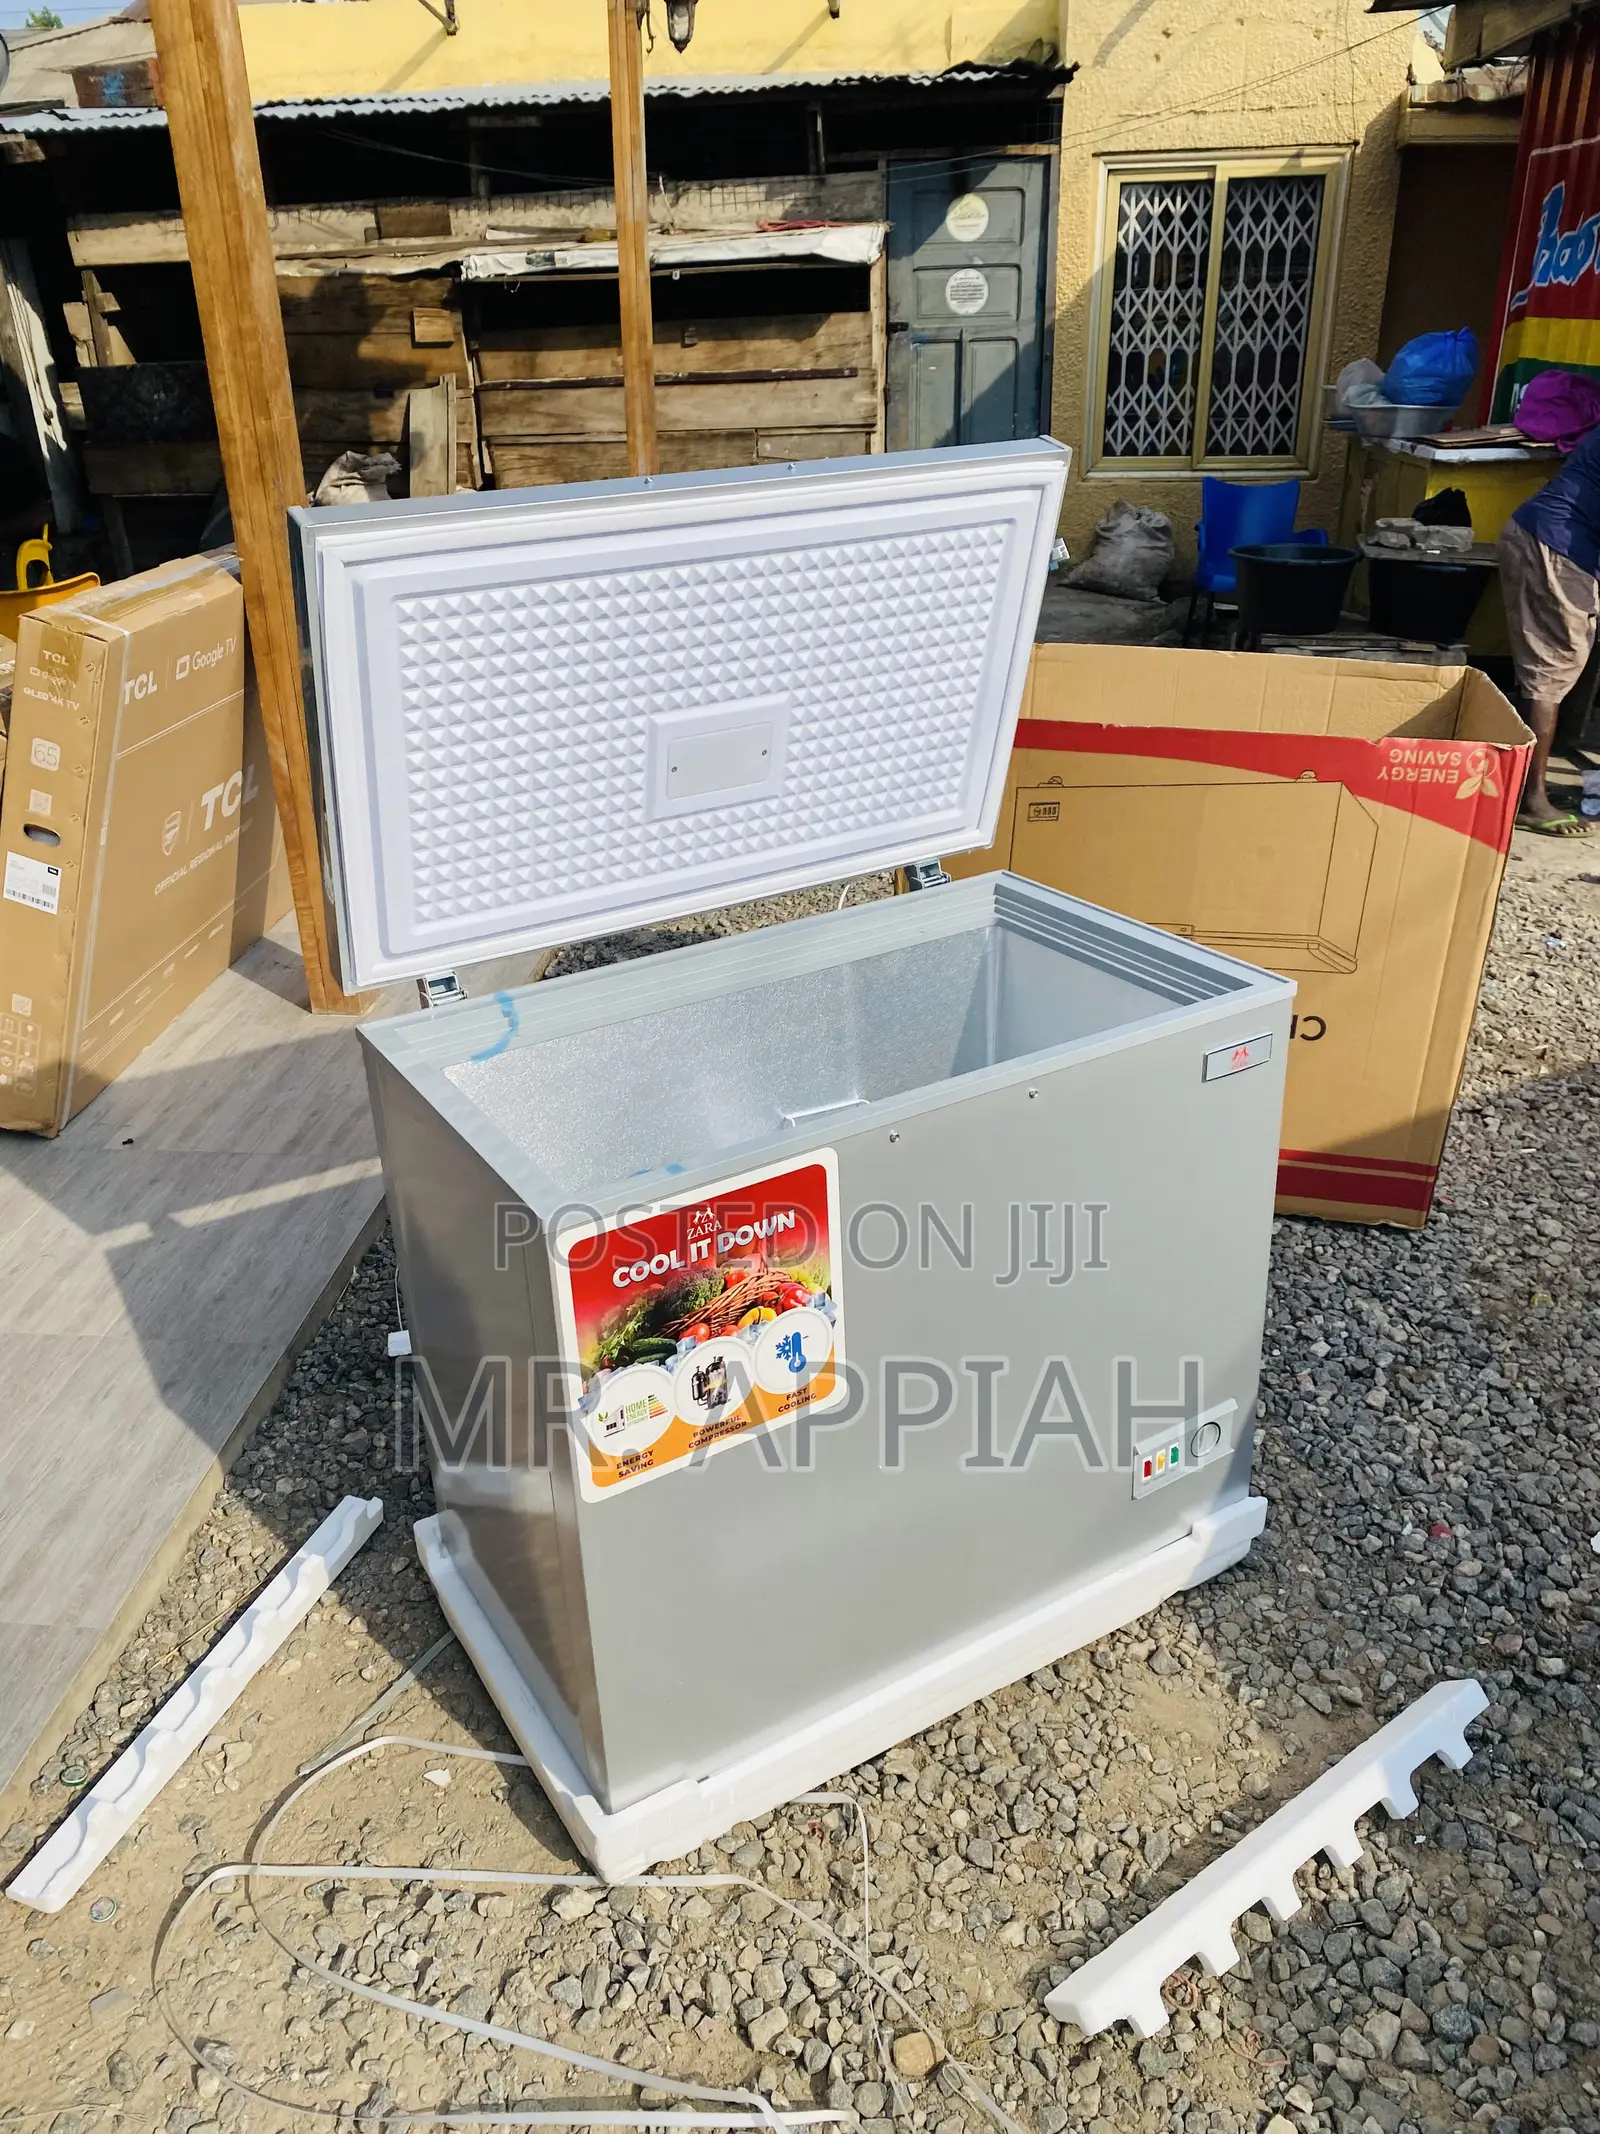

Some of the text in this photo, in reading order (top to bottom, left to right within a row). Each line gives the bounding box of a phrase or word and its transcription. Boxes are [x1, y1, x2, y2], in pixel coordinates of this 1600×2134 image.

[43, 650, 69, 667] TCL
[124, 635, 238, 706] TCL Google TV
[23, 686, 50, 702] QLED
[65, 699, 80, 711] TV
[34, 743, 58, 767] 65
[1389, 748, 1462, 767] SAVING
[1377, 766, 1460, 785] ENERGY
[201, 763, 259, 832] TCL
[686, 1219, 723, 1240] ZARA
[612, 1209, 796, 1288] COOL IT DOWN
[777, 1393, 817, 1413] COOLING
[786, 1387, 808, 1401] FAST
[625, 1398, 648, 1415] HOME
[625, 1407, 649, 1422] ENERGY
[688, 1421, 748, 1449] COMPRESSOR
[693, 1415, 742, 1438] POWERFUL
[616, 1449, 655, 1470] ENERGY
[618, 1459, 655, 1479] SAVING
